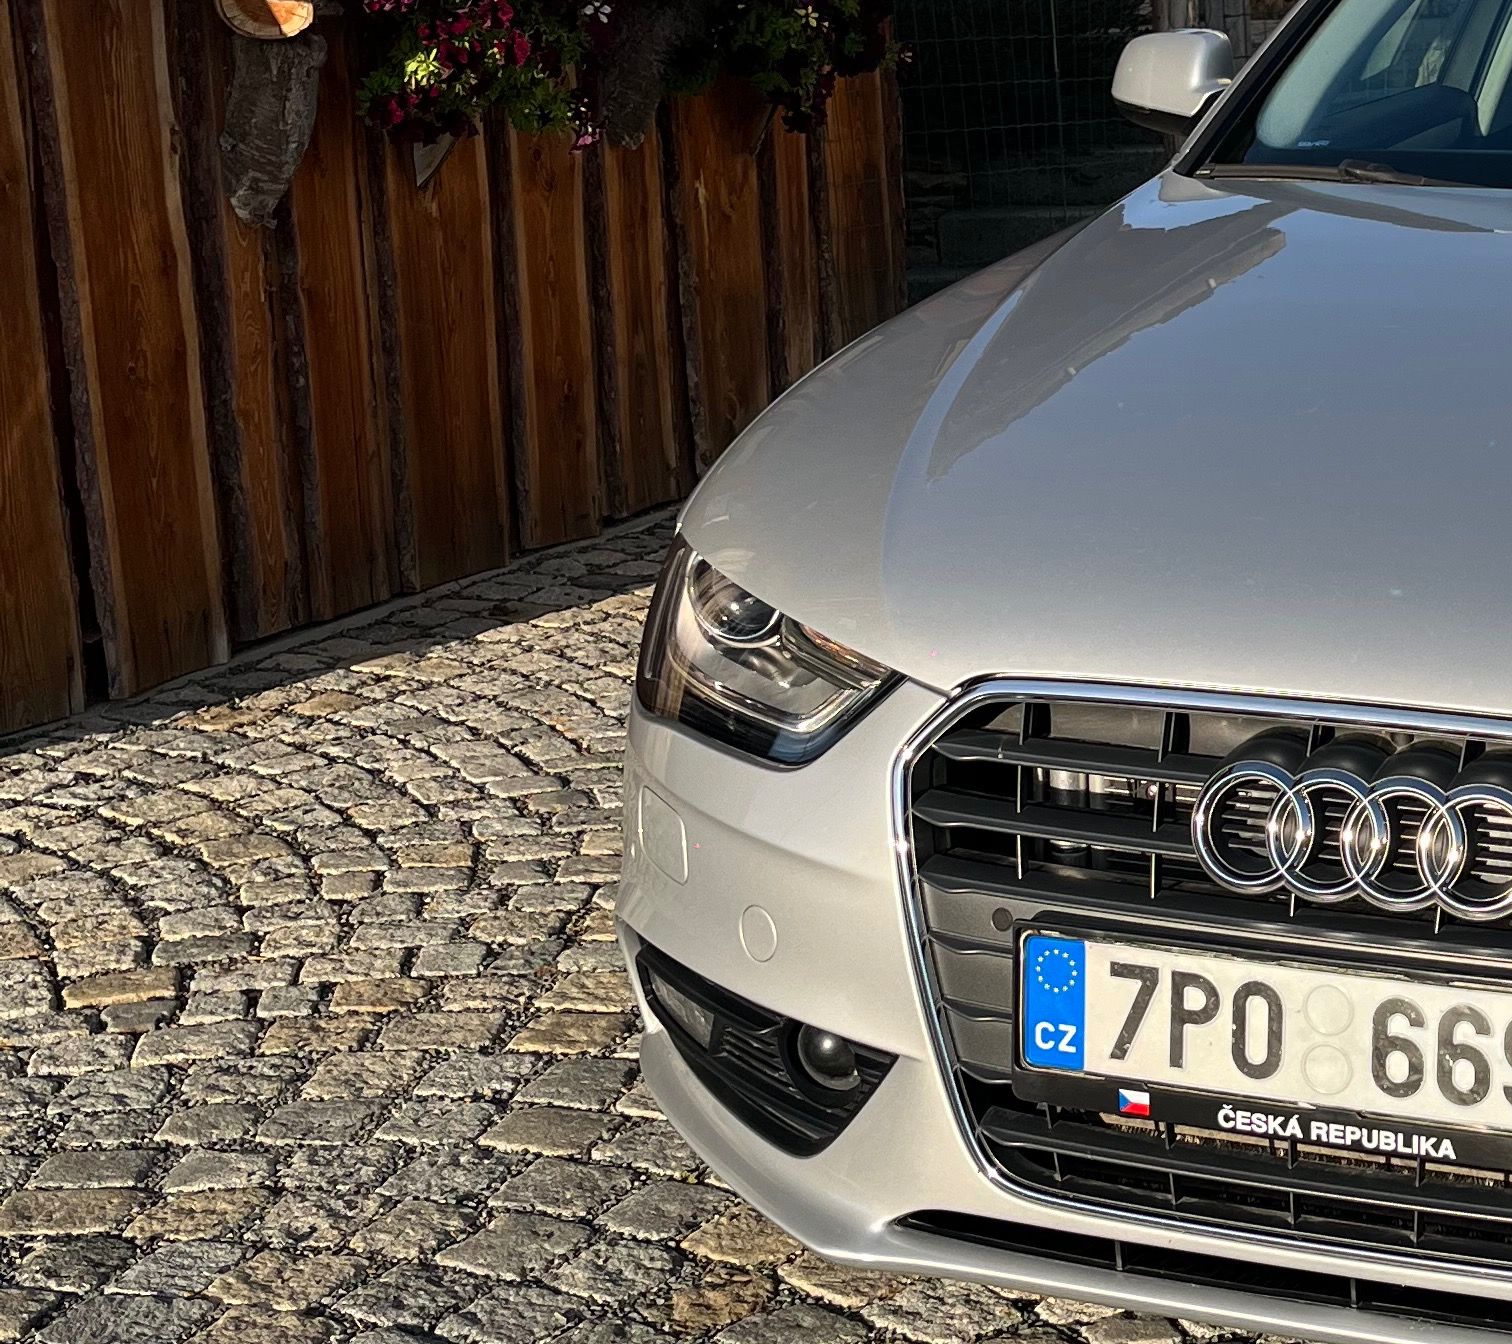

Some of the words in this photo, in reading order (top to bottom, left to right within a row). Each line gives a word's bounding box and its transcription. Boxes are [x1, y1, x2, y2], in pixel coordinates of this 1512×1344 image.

[1034, 1021, 1077, 1054] CZ
[1109, 960, 1284, 1080] 7P0
[1217, 1104, 1303, 1139] ČESKÁ
[1310, 1121, 1457, 1159] REPUBLIKA
